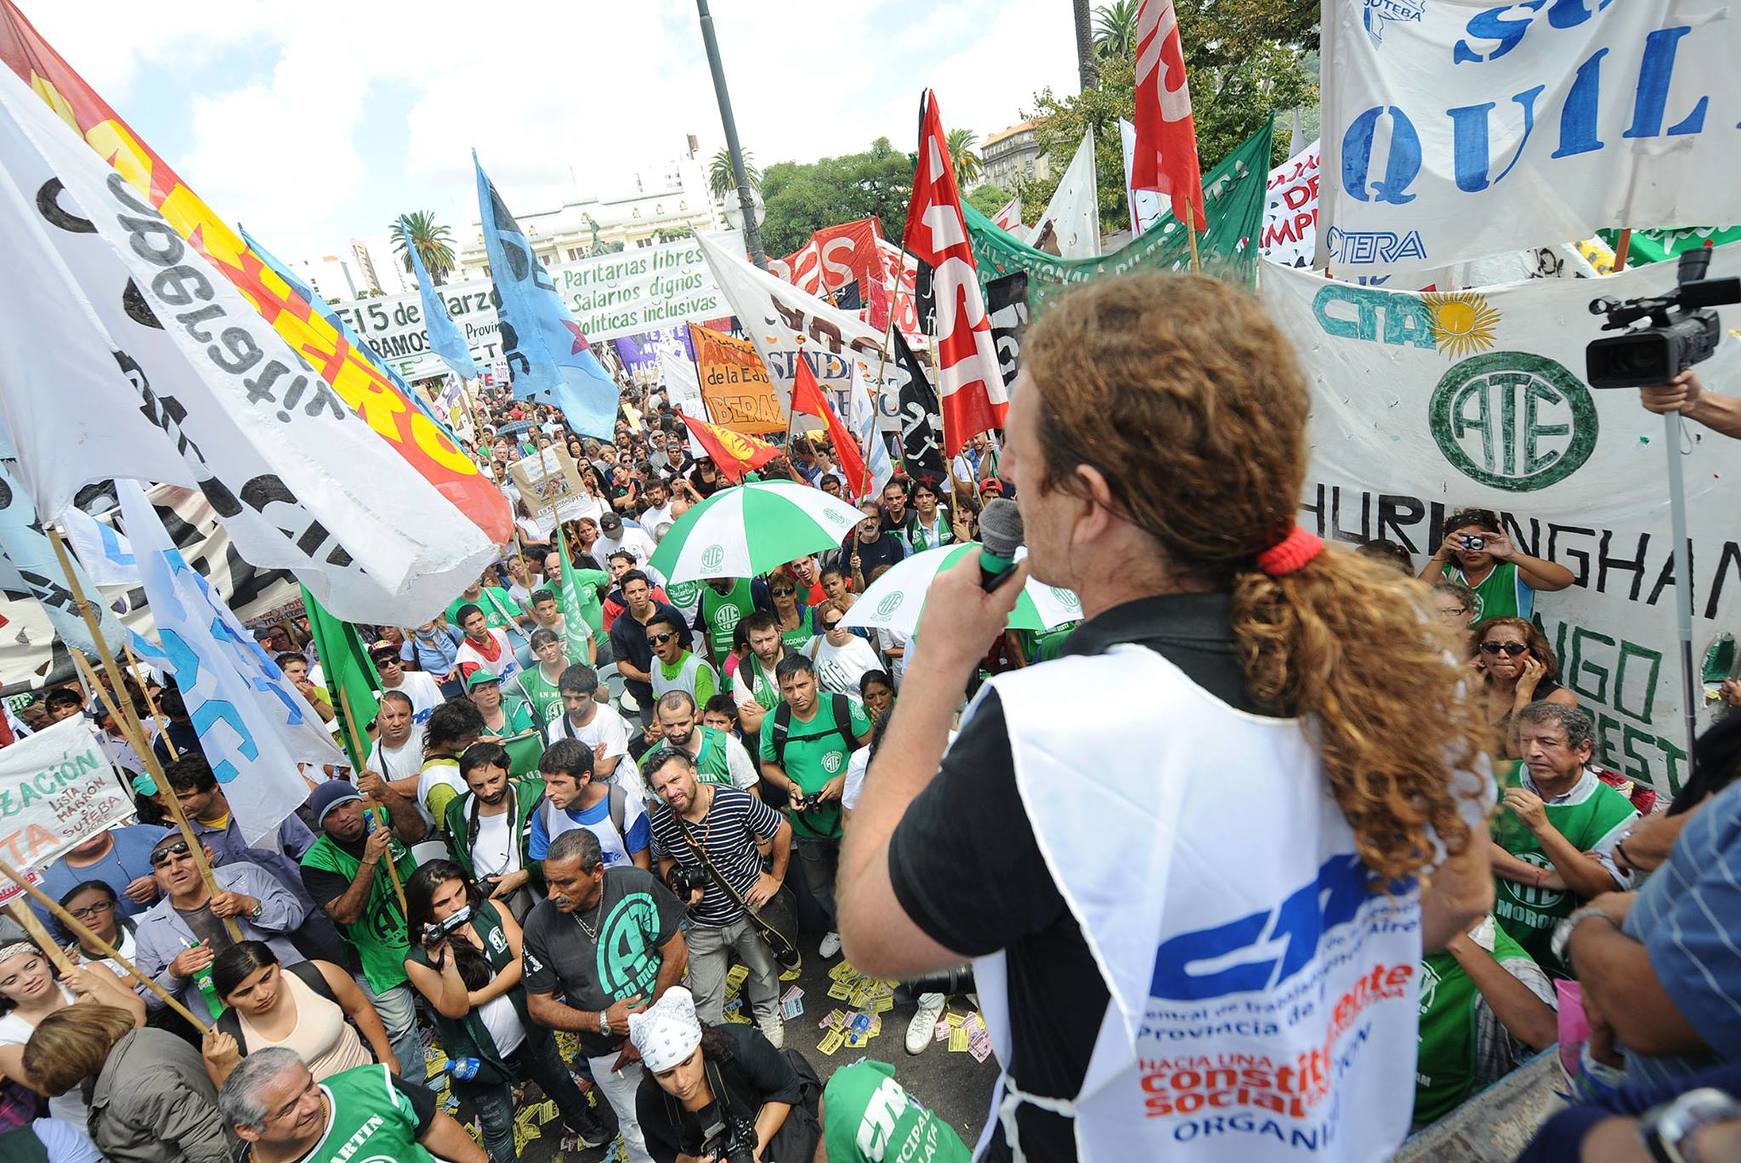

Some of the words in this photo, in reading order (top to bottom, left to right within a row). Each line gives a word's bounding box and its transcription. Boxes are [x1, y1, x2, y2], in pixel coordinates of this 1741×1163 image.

[1341, 26, 1741, 205] QUIL
[563, 257, 648, 290] Paritarias
[652, 248, 705, 272] libres
[570, 285, 641, 313] Salarios
[650, 272, 703, 300] dignos
[643, 295, 718, 324] inclusivas
[394, 301, 422, 327] de
[1311, 283, 1437, 350] CTA
[1452, 371, 1570, 477] ATE
[1139, 1053, 1211, 1073] HACIA
